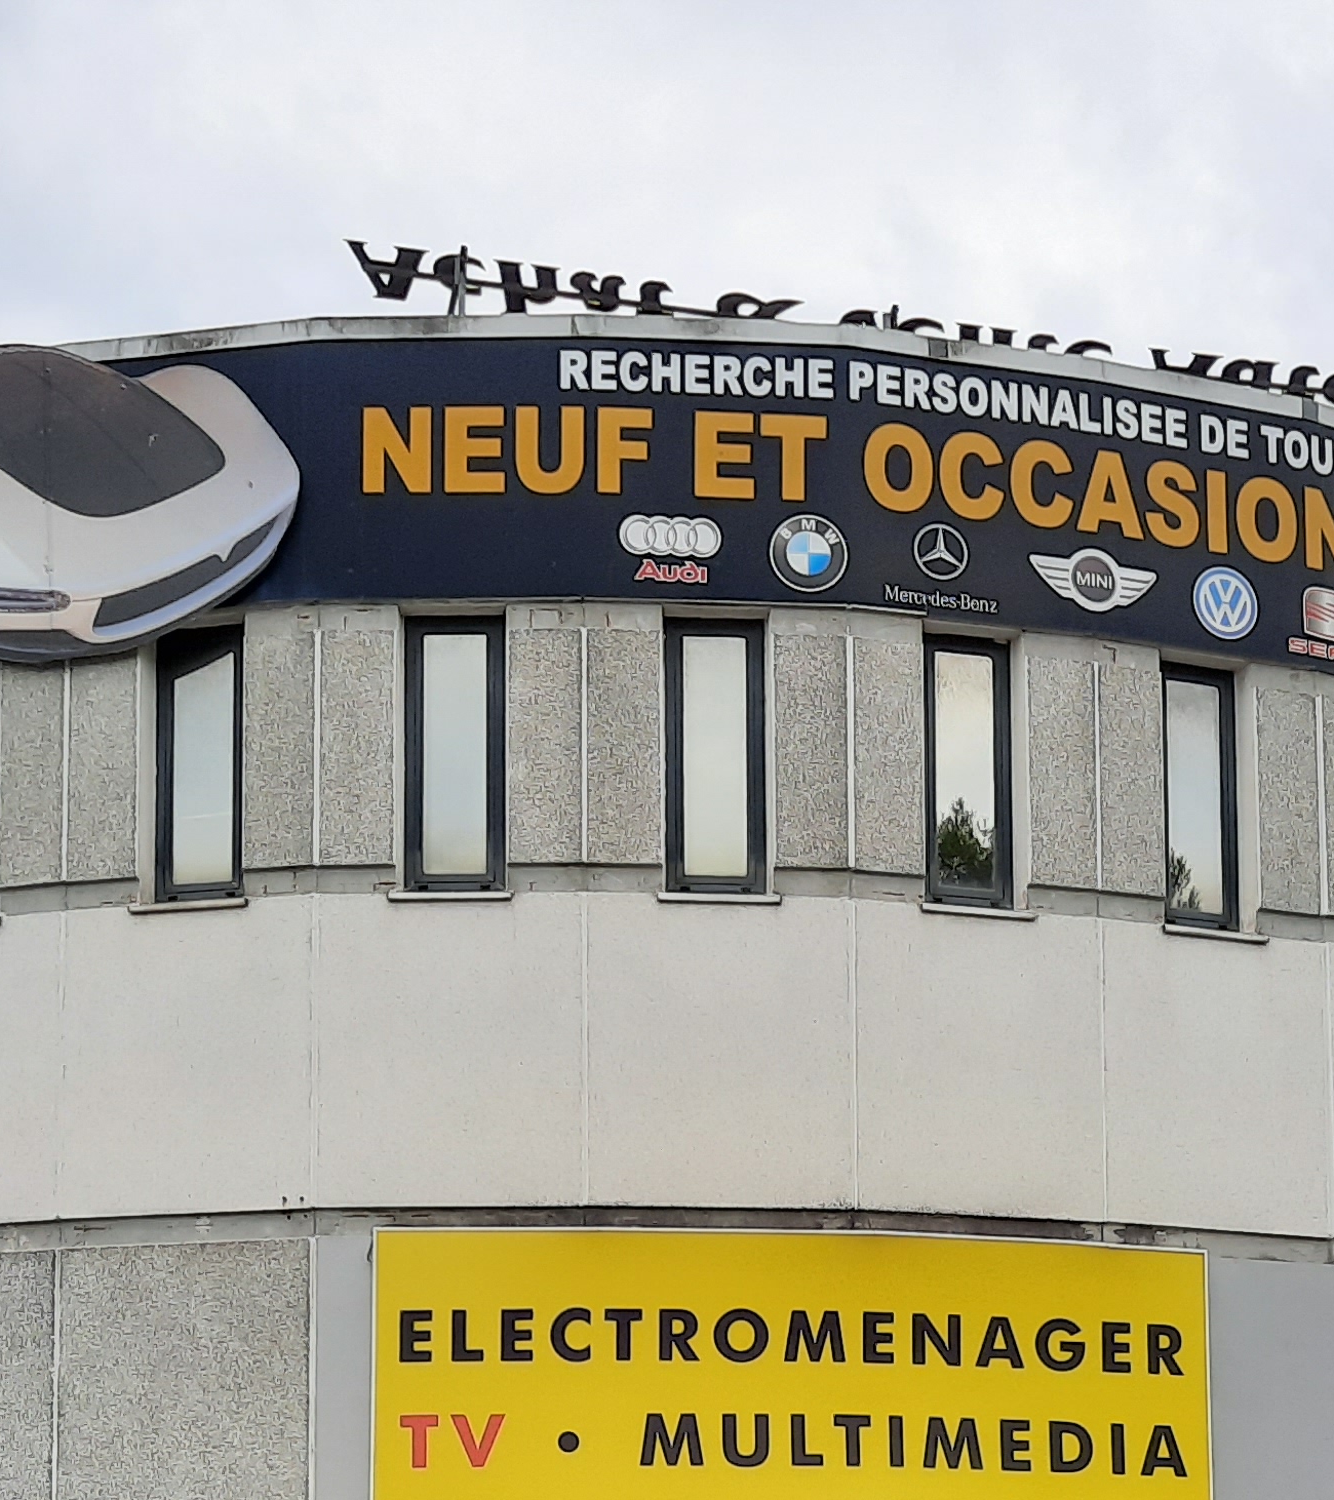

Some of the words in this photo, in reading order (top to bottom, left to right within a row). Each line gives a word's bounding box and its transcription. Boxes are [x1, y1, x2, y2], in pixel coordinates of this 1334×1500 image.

[559, 349, 835, 400] RECHERCHE
[848, 359, 1188, 449] PERSONNALISEE
[1200, 412, 1250, 459] DE
[361, 404, 655, 494] NEUF
[693, 410, 828, 501] ET
[634, 559, 709, 585] Audi
[884, 584, 998, 613] Mercedes-Benz
[1076, 570, 1113, 591] MINI
[399, 1307, 1184, 1376] ELECTROMENAGER
[399, 1413, 505, 1468] TV
[639, 1413, 1188, 1477] MULTIMEDIA
